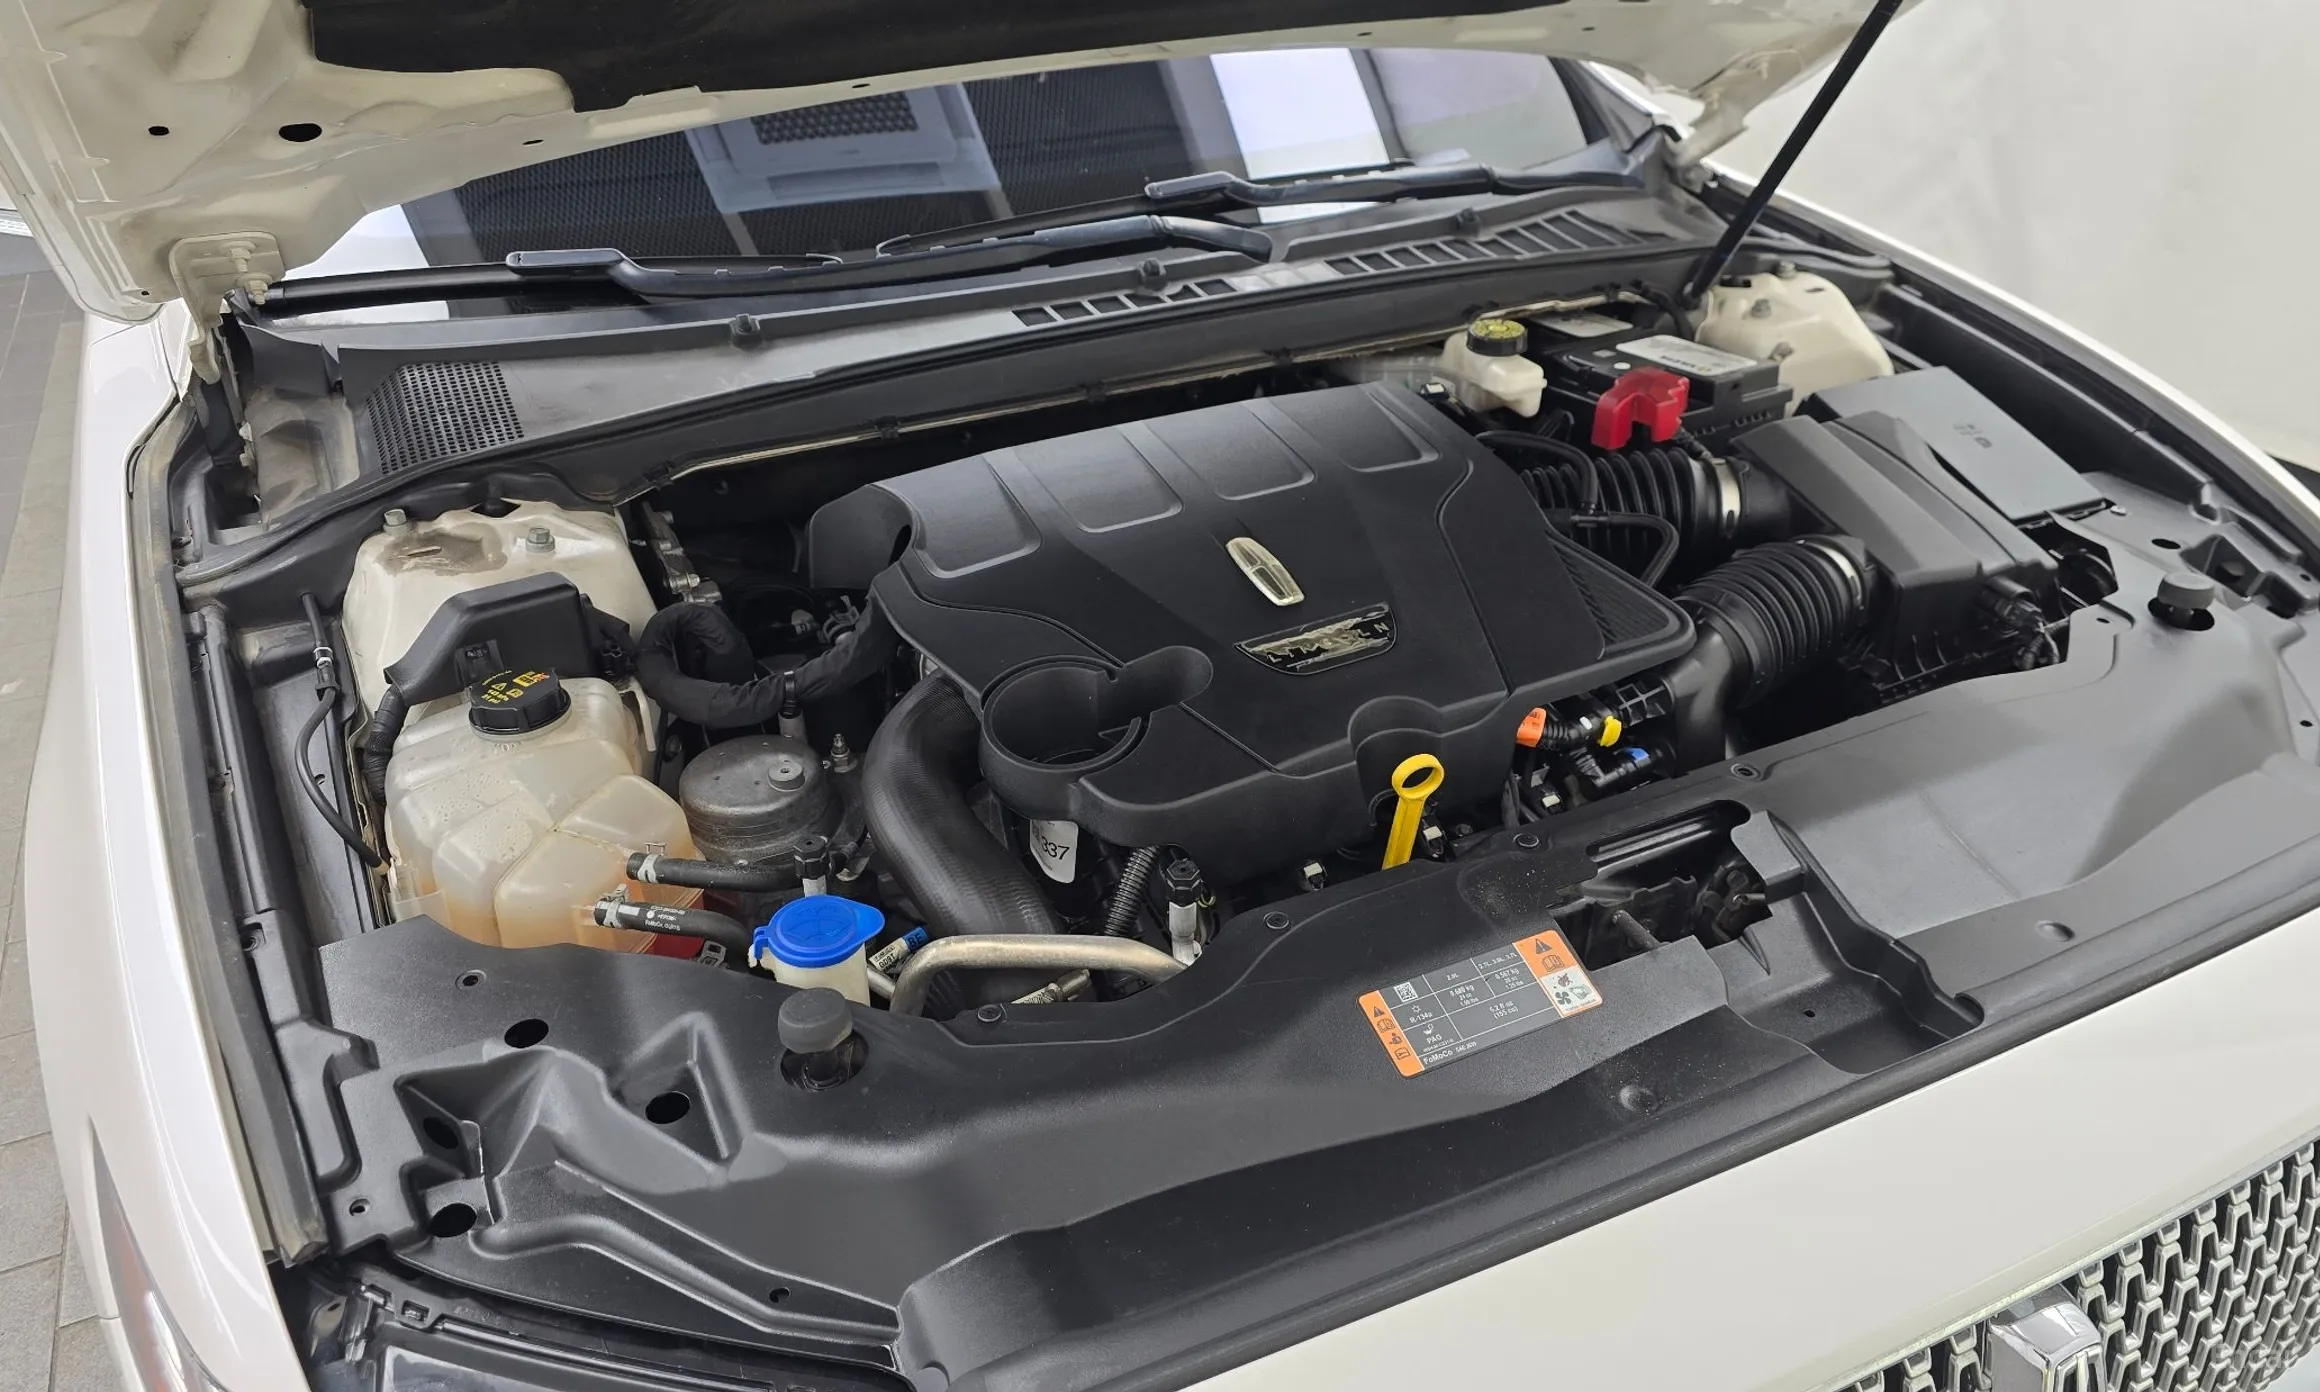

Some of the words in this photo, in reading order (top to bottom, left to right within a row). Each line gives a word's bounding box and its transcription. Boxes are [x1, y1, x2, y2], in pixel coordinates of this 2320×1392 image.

[1041, 836, 1070, 860] 337
[1410, 1012, 1433, 1023] R-134a
[1426, 1034, 1442, 1044] PAG
[1423, 1050, 1453, 1064] FoMoCo
